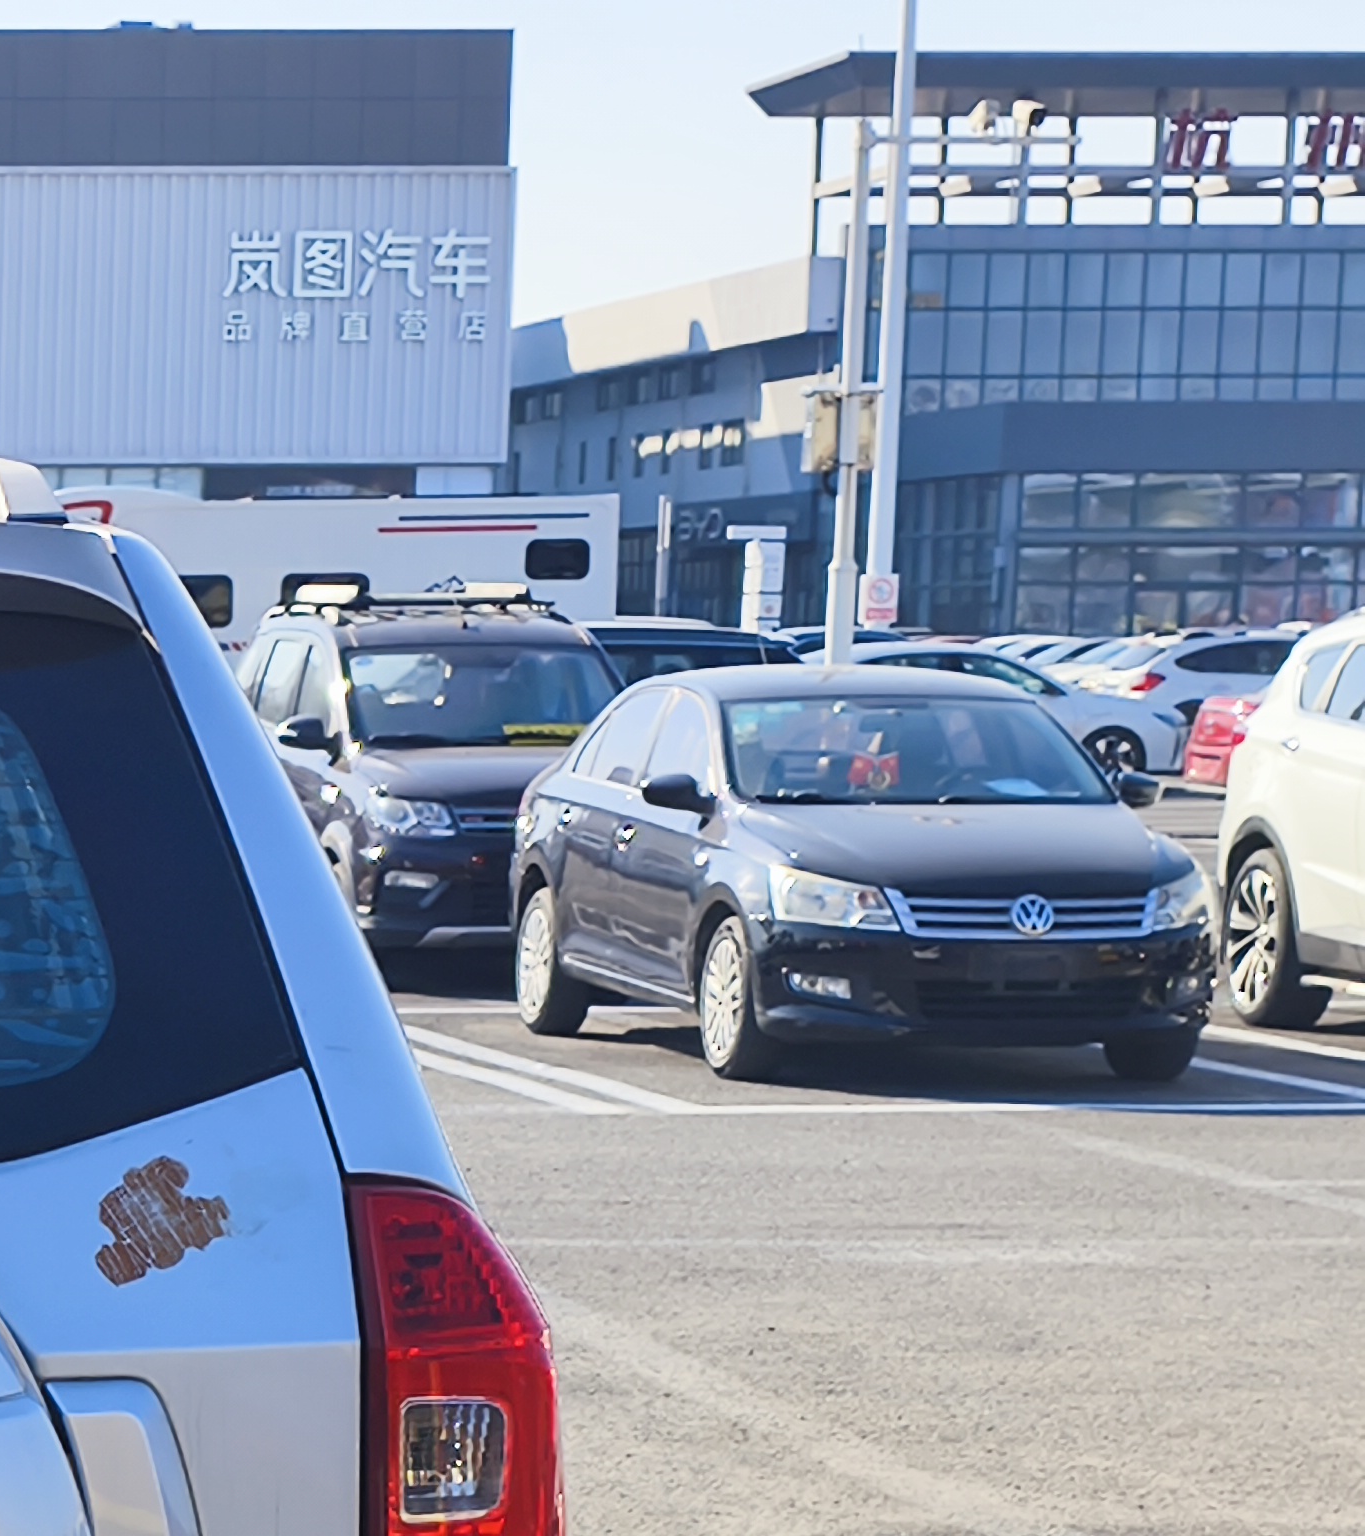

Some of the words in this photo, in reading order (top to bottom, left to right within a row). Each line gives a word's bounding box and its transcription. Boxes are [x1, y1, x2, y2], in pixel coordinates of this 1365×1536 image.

[222, 228, 491, 299] 岚图汽车
[222, 310, 487, 342] 品牌直营店
